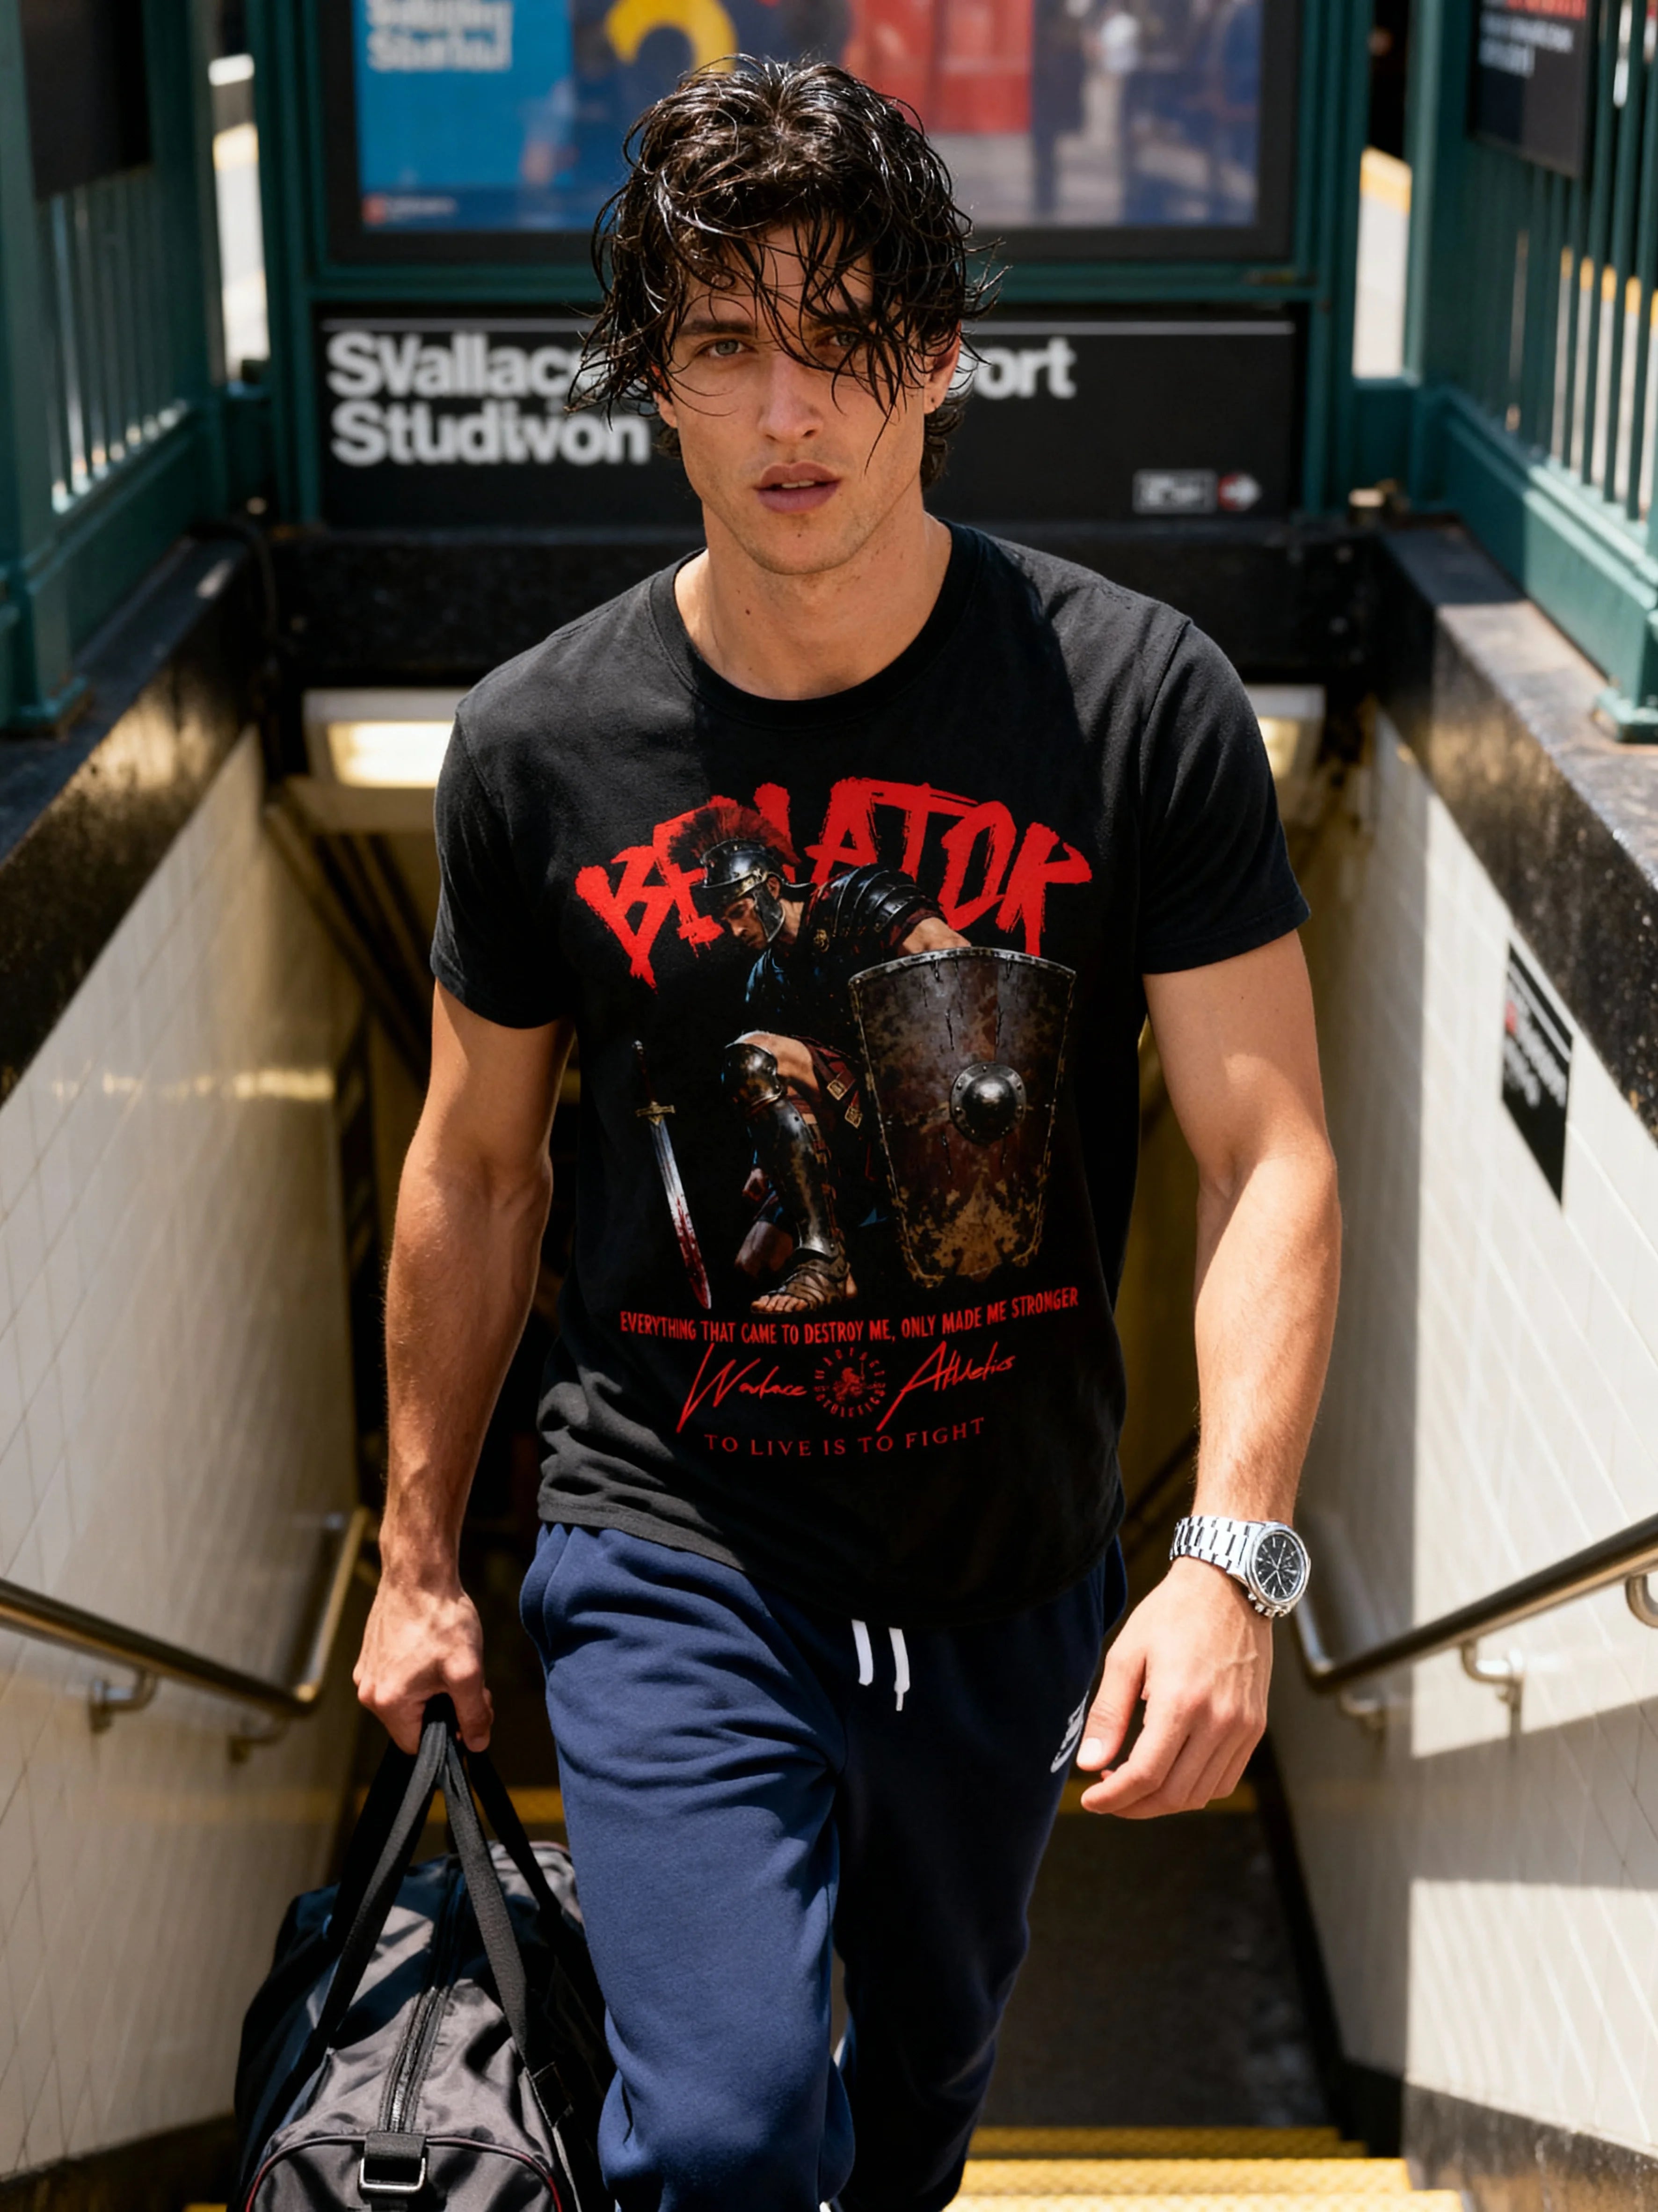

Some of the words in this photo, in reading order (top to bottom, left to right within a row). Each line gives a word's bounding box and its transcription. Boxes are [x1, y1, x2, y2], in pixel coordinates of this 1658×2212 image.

[620, 1311, 697, 1340] EVERYTHING
[700, 1320, 736, 1343] THAT
[741, 1323, 777, 1344] CAME
[781, 1324, 799, 1345] TO
[804, 1320, 864, 1344] DESTROY
[869, 1319, 896, 1343] ME,
[901, 1315, 936, 1338] ONLY
[942, 1307, 982, 1334] MADE
[987, 1300, 1007, 1325] ME
[1011, 1287, 1078, 1318] STRONGER
[705, 1434, 738, 1452] TO
[751, 1439, 810, 1456] LIVE
[824, 1439, 845, 1455] IS
[858, 1435, 894, 1453] TO
[906, 1417, 984, 1448] FIGHT
